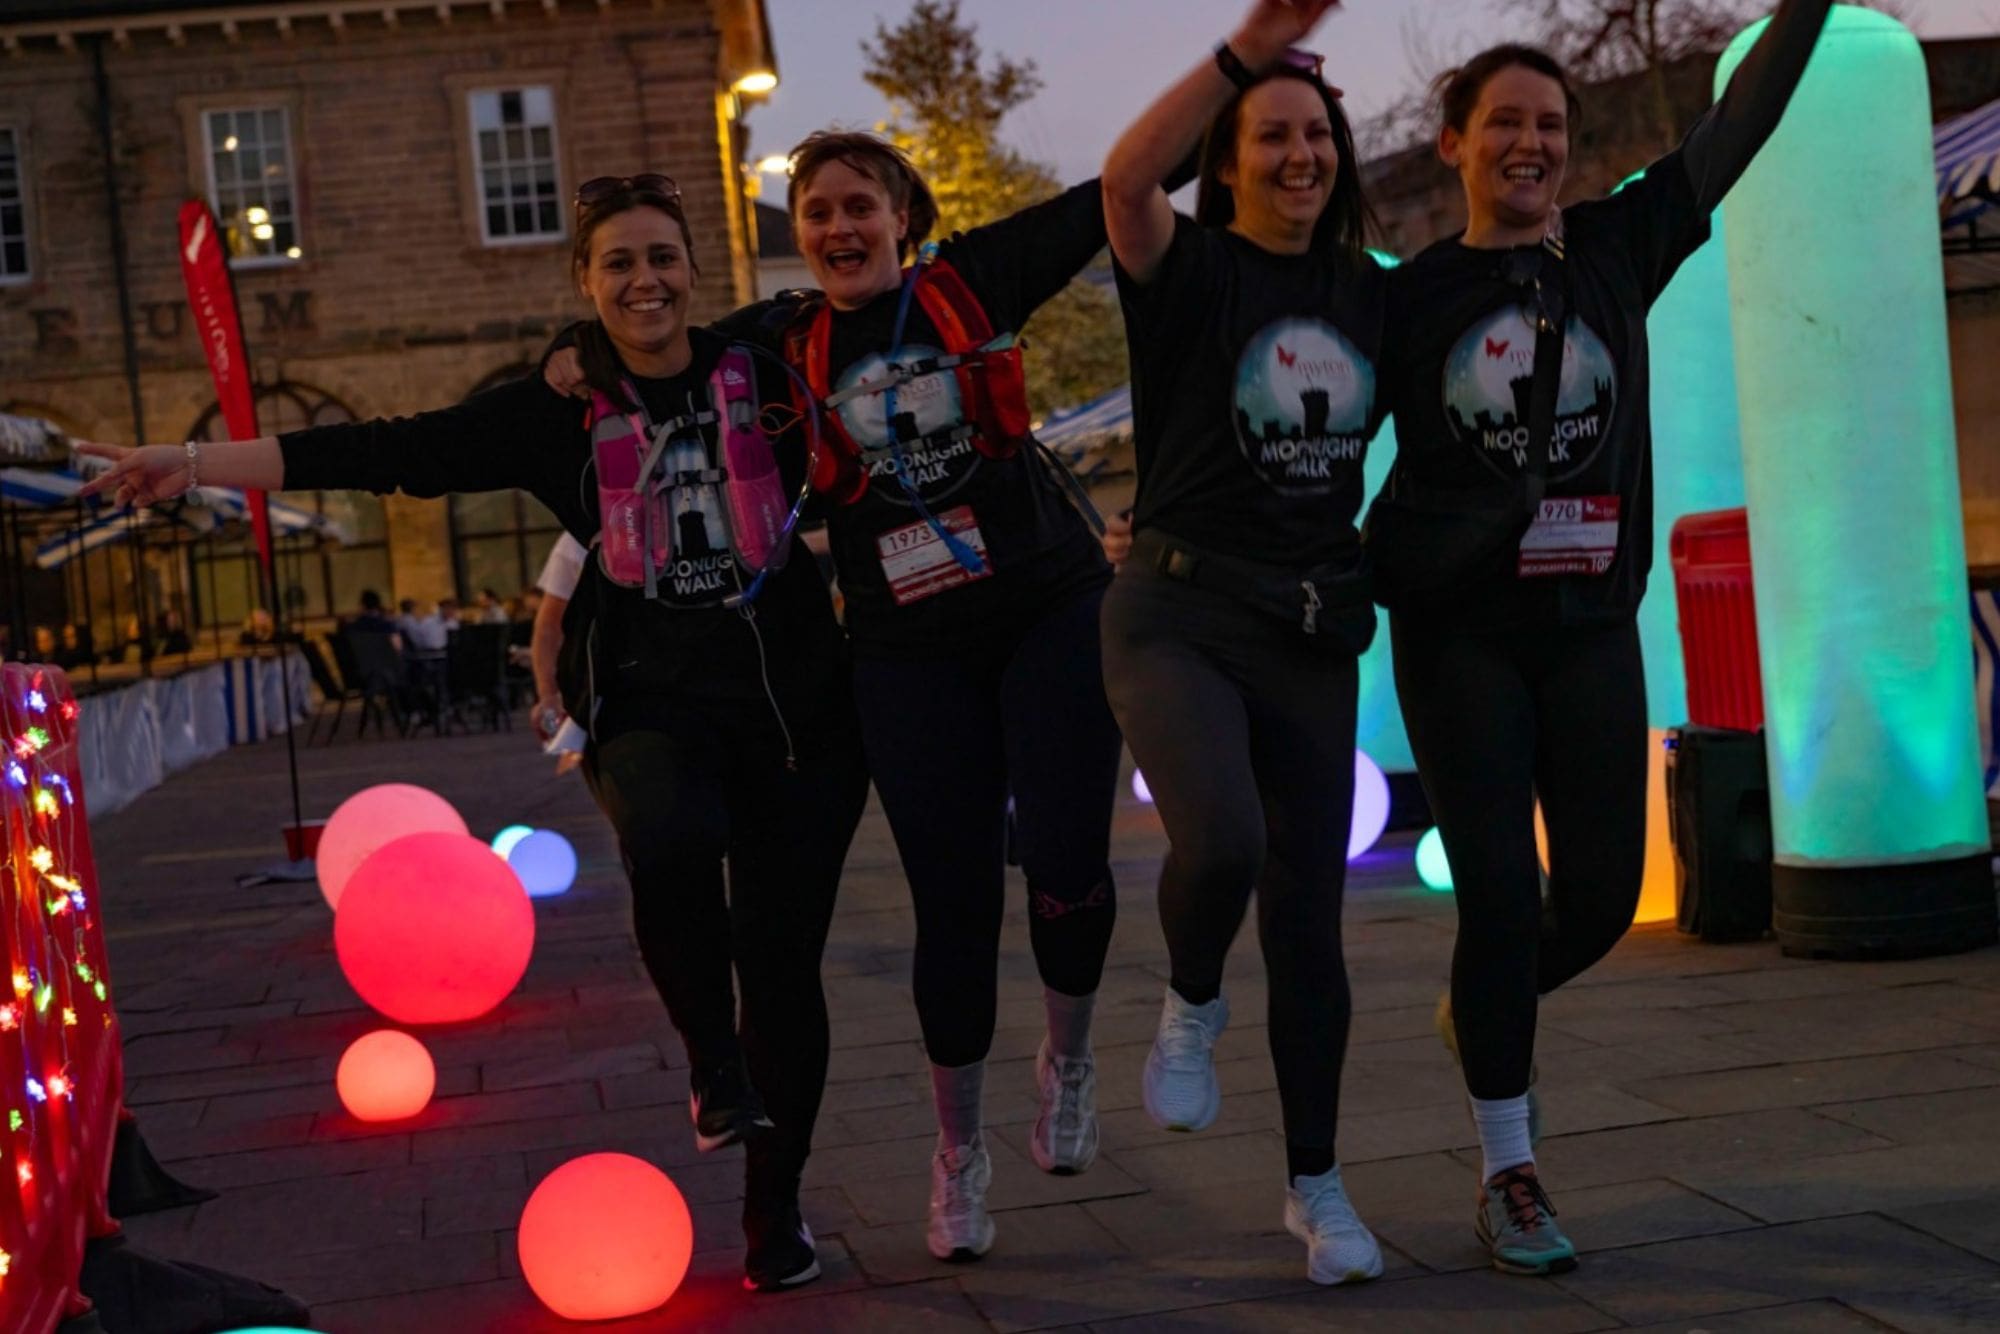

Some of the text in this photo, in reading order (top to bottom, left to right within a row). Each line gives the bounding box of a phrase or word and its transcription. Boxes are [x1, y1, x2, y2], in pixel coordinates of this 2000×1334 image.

[1513, 441, 1571, 467] WLK
[907, 461, 951, 488] ALK
[888, 525, 932, 551] 1973
[674, 570, 727, 595] WALK
